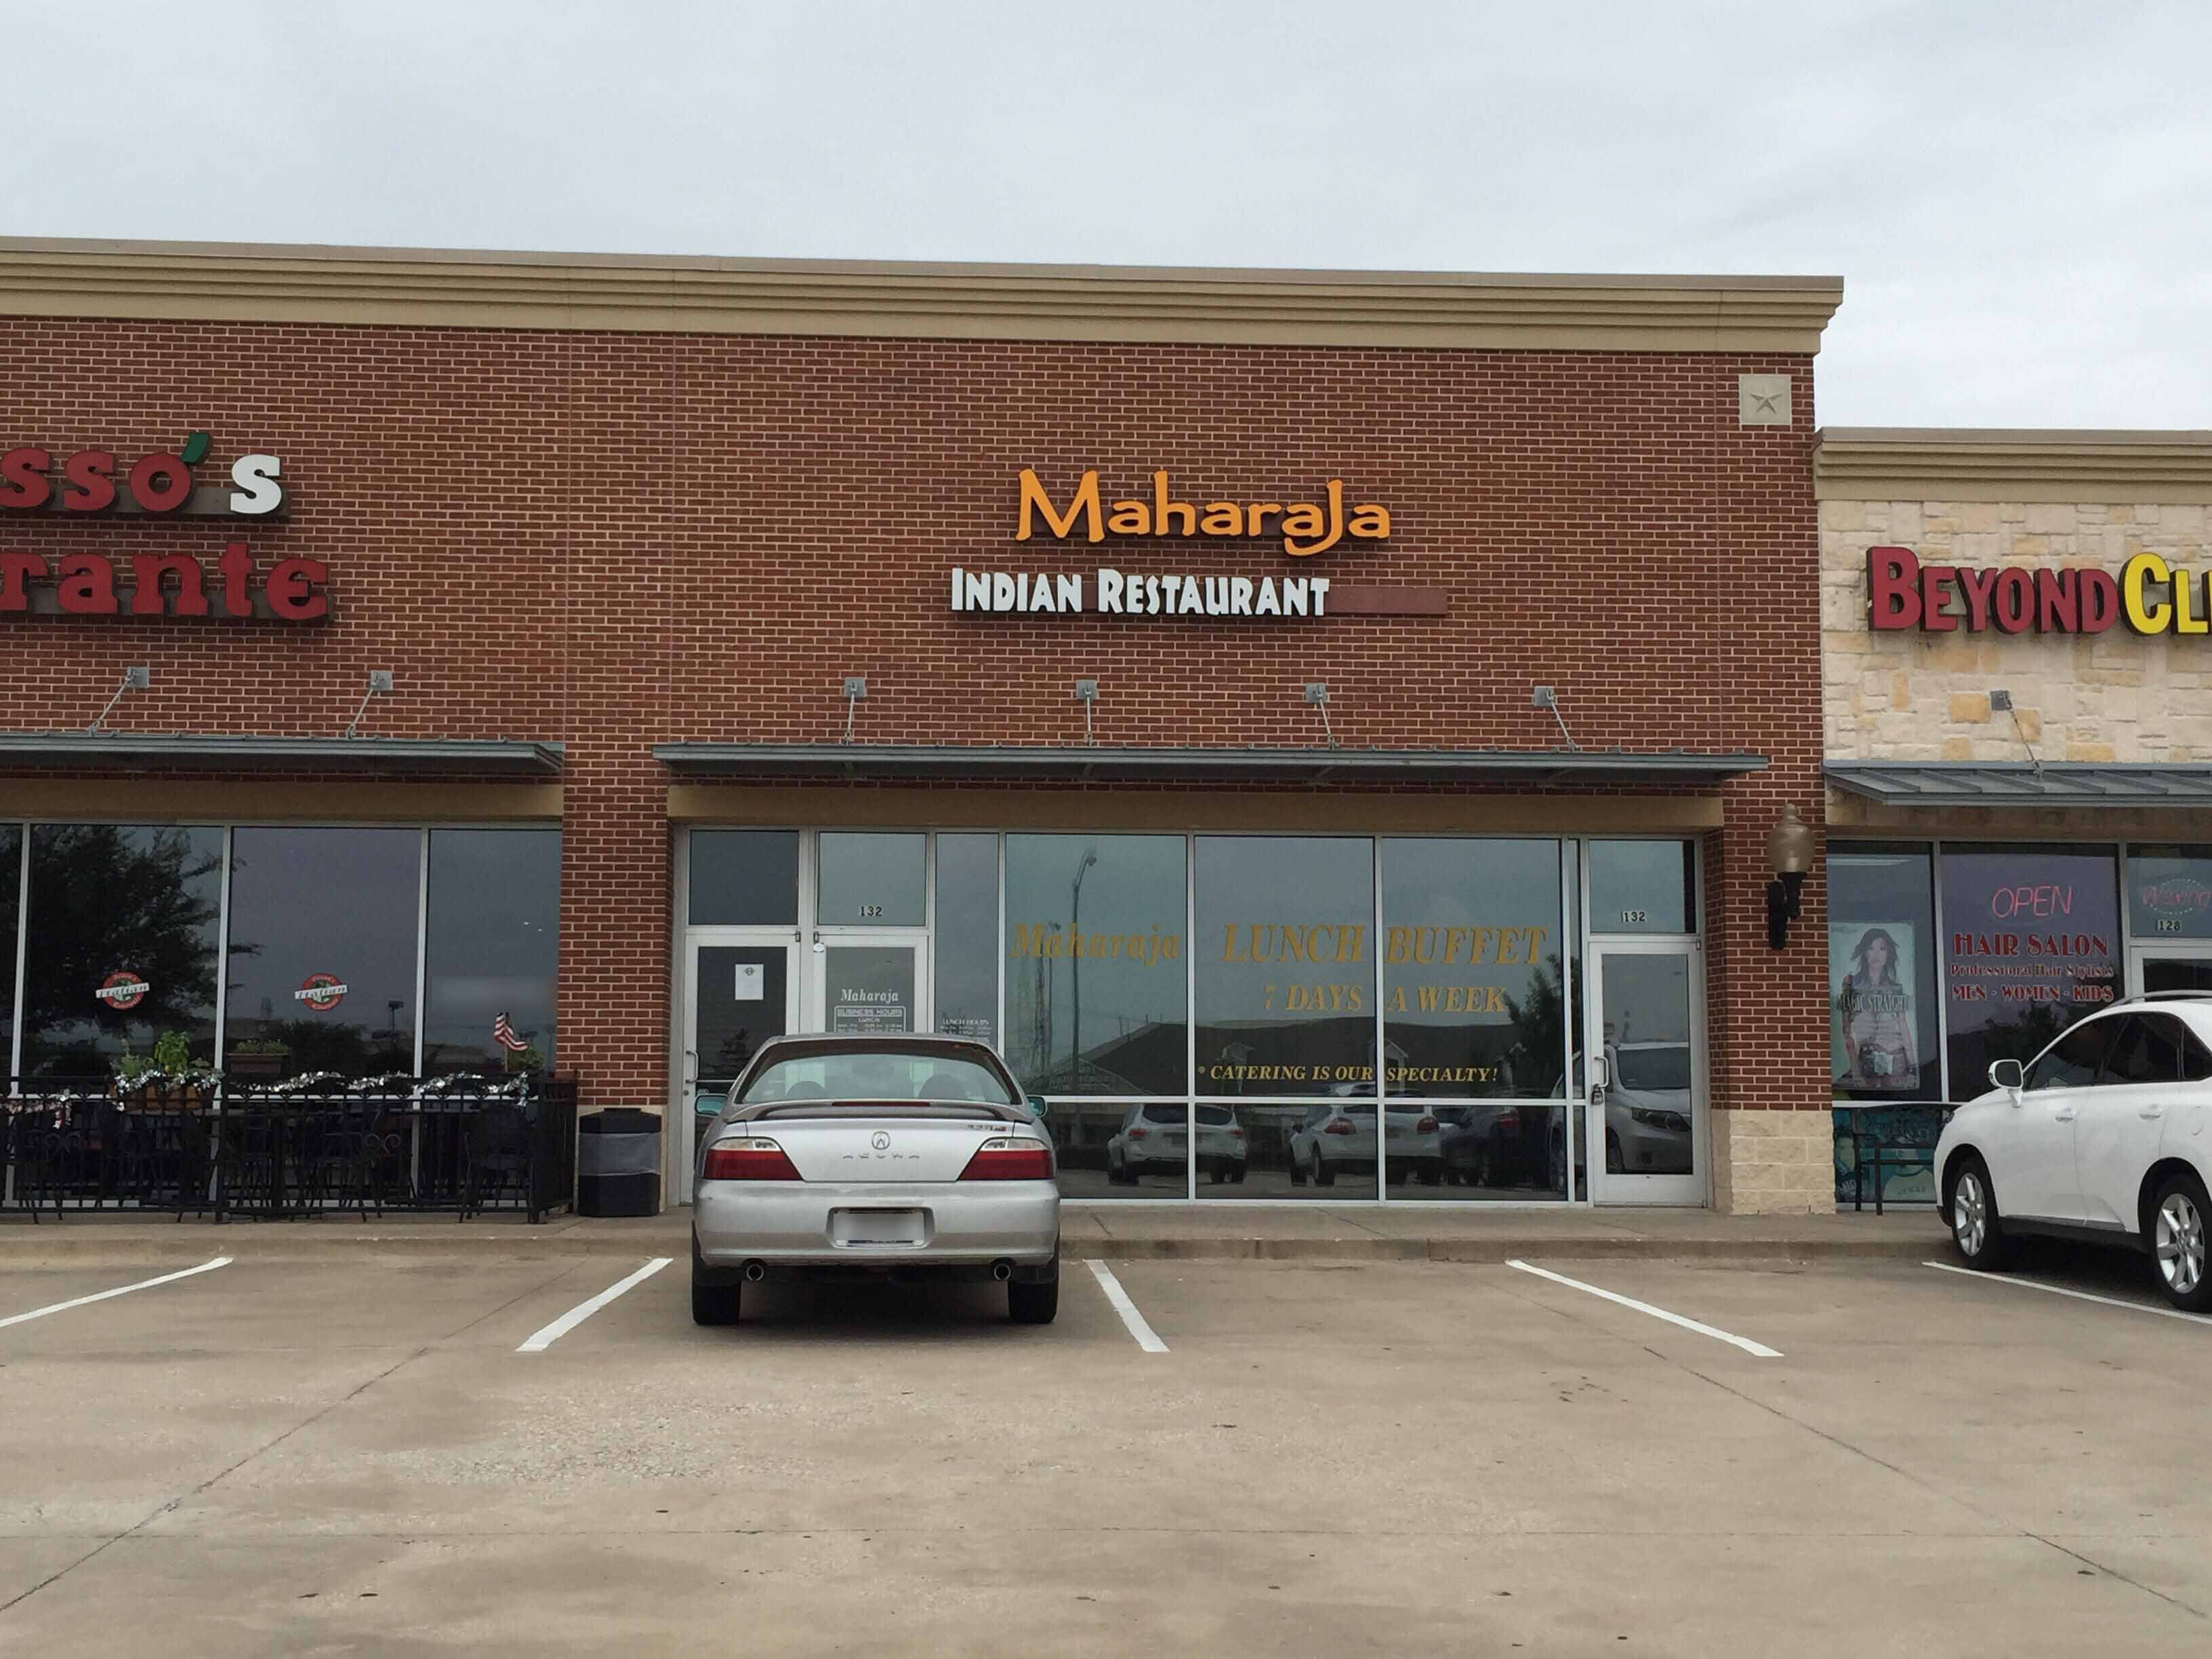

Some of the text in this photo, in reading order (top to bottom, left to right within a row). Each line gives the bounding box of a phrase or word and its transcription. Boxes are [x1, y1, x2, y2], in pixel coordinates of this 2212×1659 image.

[951, 567, 1330, 617] INDIAN RESTAURANT
[1867, 546, 2212, 635] BEYOND CL
[1992, 884, 2072, 918] OPEN
[860, 905, 882, 917] 132
[1623, 911, 1646, 922] 132
[2158, 920, 2181, 931] 128
[1008, 921, 1548, 966] Maharaja LUNCH BUFFET
[1954, 933, 2110, 957] HAIR SALON
[1950, 963, 2031, 977] Professional
[2035, 963, 2062, 977] Hair
[840, 988, 899, 1004] Maharaja
[1263, 984, 1508, 1014] 7 DAYS A WEEK
[1952, 983, 2114, 1002] MEN WOMEN KIDS
[1210, 1065, 1498, 1082] CATERING IS OUR SPECIALTY!
